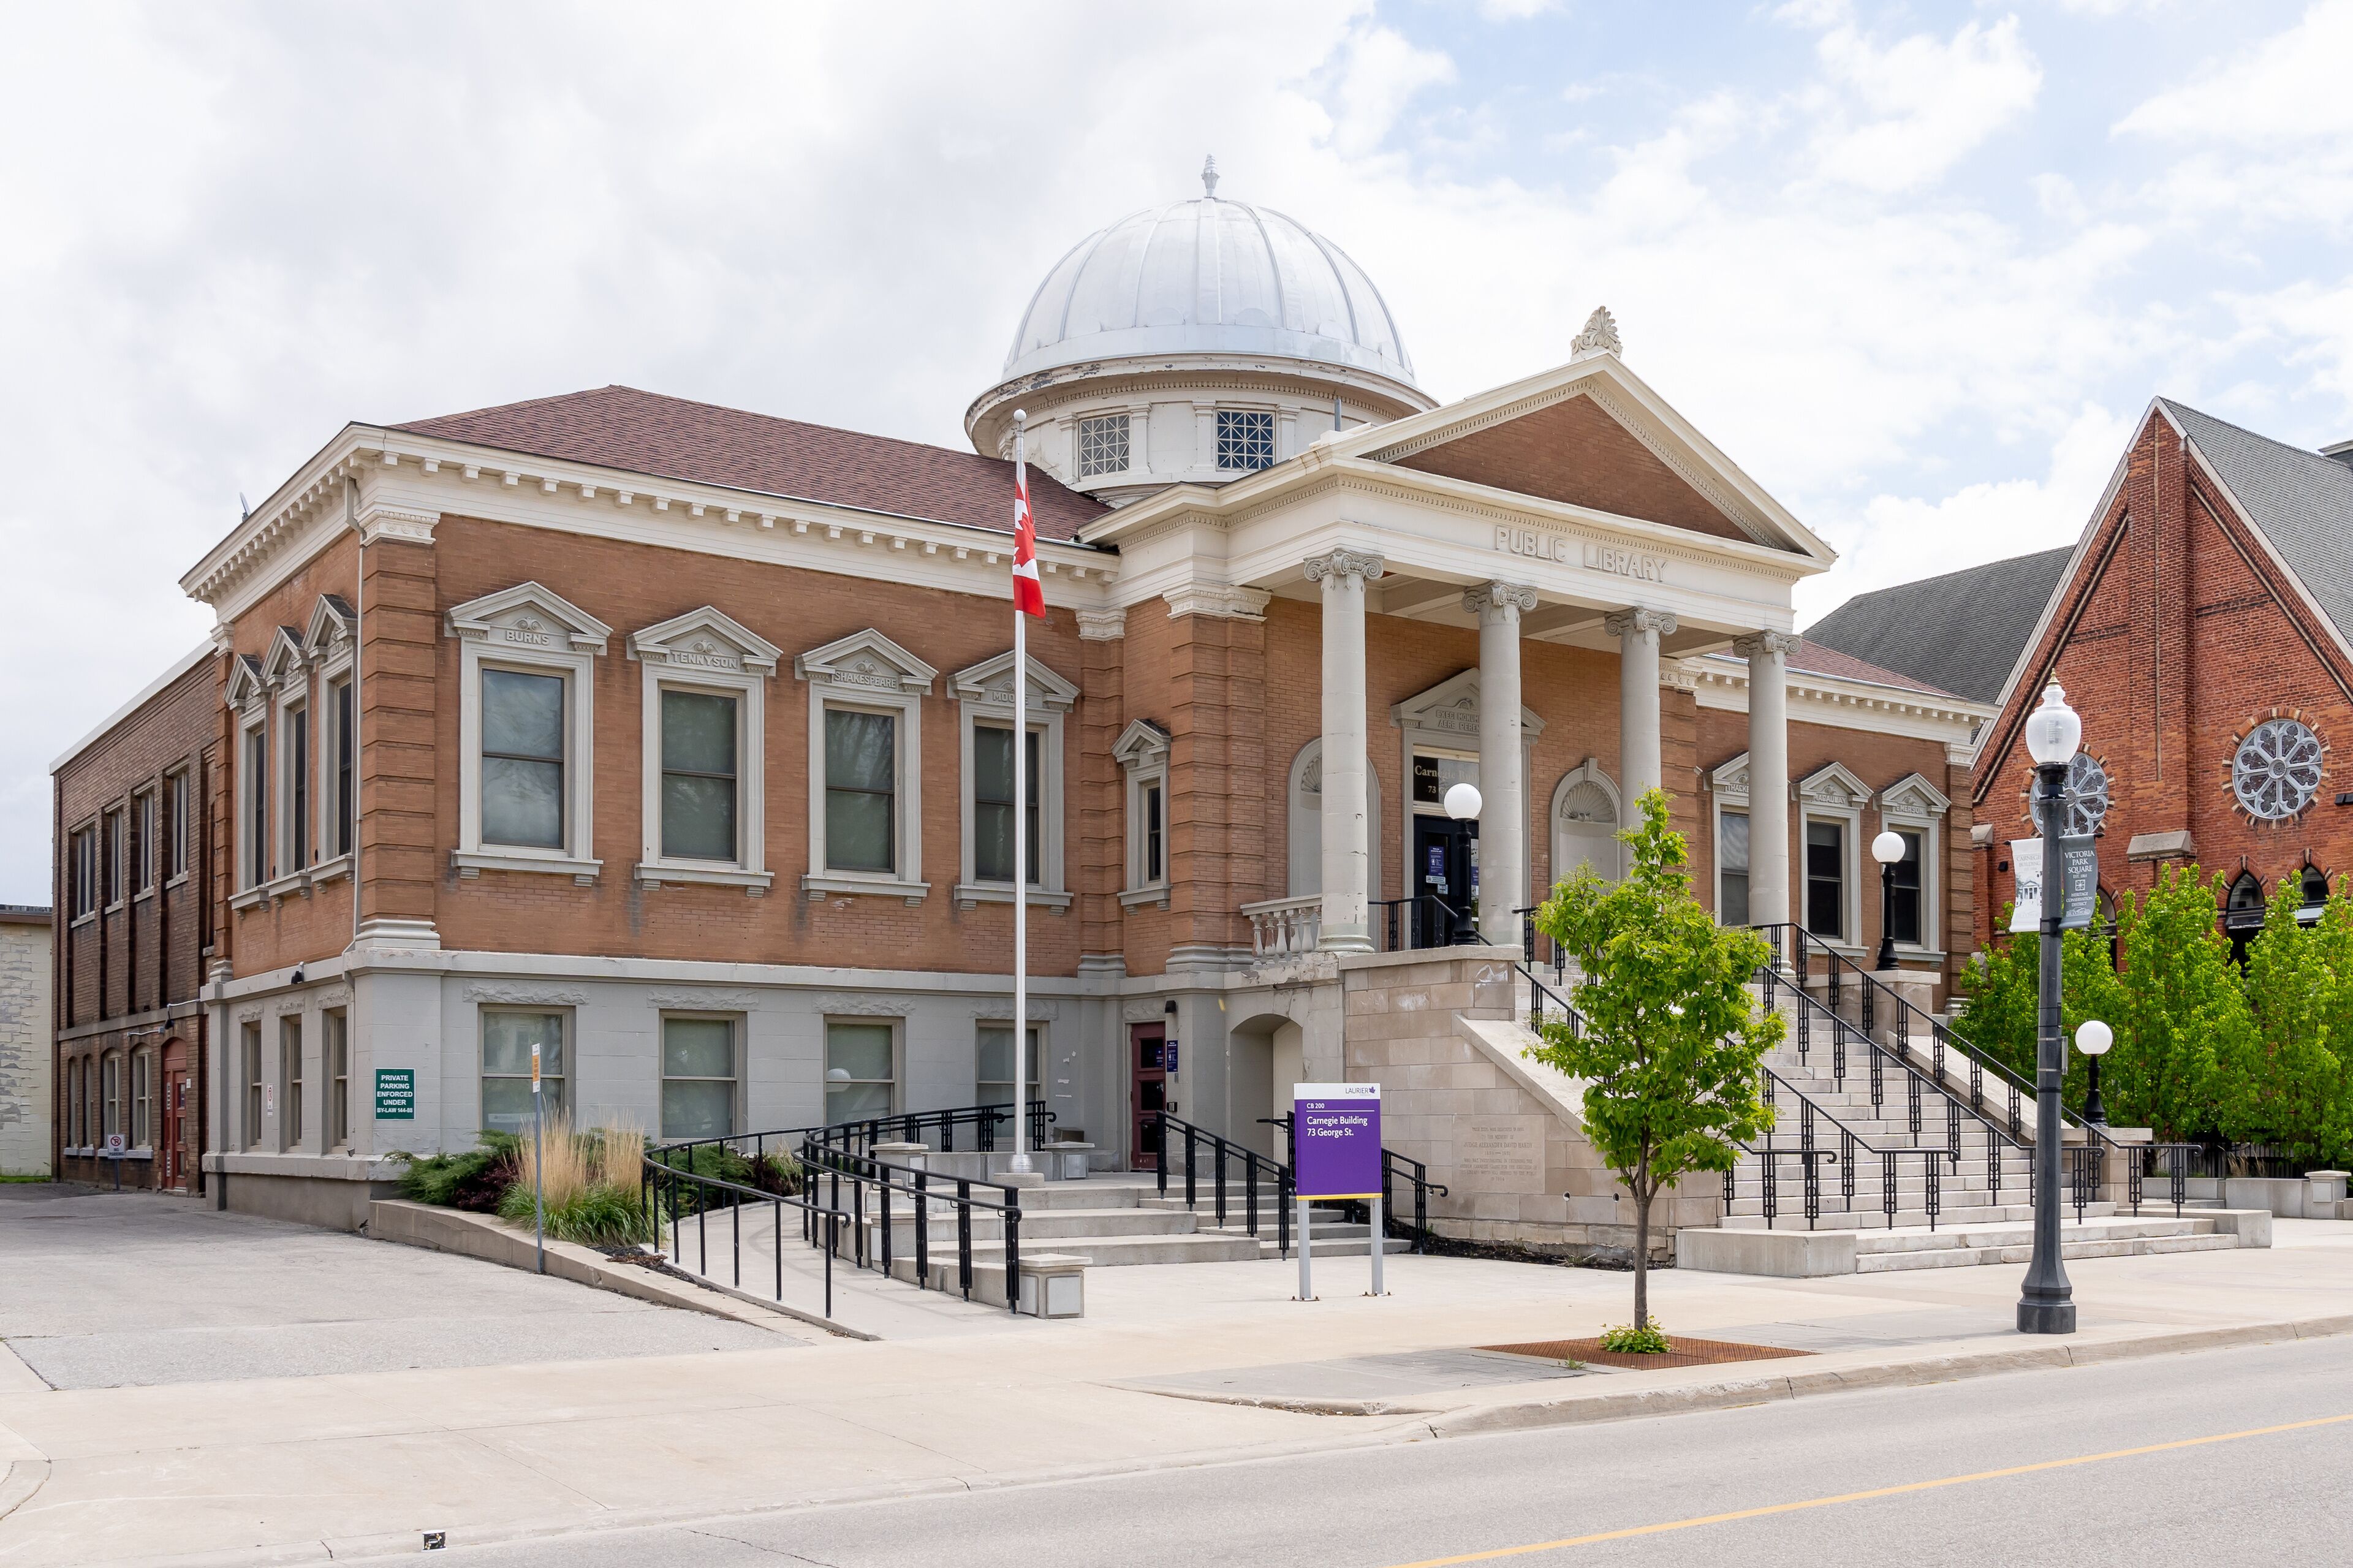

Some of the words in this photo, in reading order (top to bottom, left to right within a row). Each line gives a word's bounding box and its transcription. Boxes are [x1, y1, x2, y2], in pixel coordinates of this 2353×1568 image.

[1495, 526, 1567, 562] PUBLIC
[1585, 544, 1667, 582] LIBRARY
[506, 630, 550, 645] BURNS
[672, 651, 737, 669] TENNYSON
[834, 672, 897, 689] SHAKESPEARE
[1438, 719, 1456, 729] AERE
[2067, 865, 2093, 874] SQUARE
[1306, 1116, 1338, 1127] Carnegie
[1339, 1115, 1368, 1126] Building
[1307, 1128, 1316, 1137] 73
[1317, 1127, 1343, 1138] George
[1344, 1127, 1354, 1136] St.
